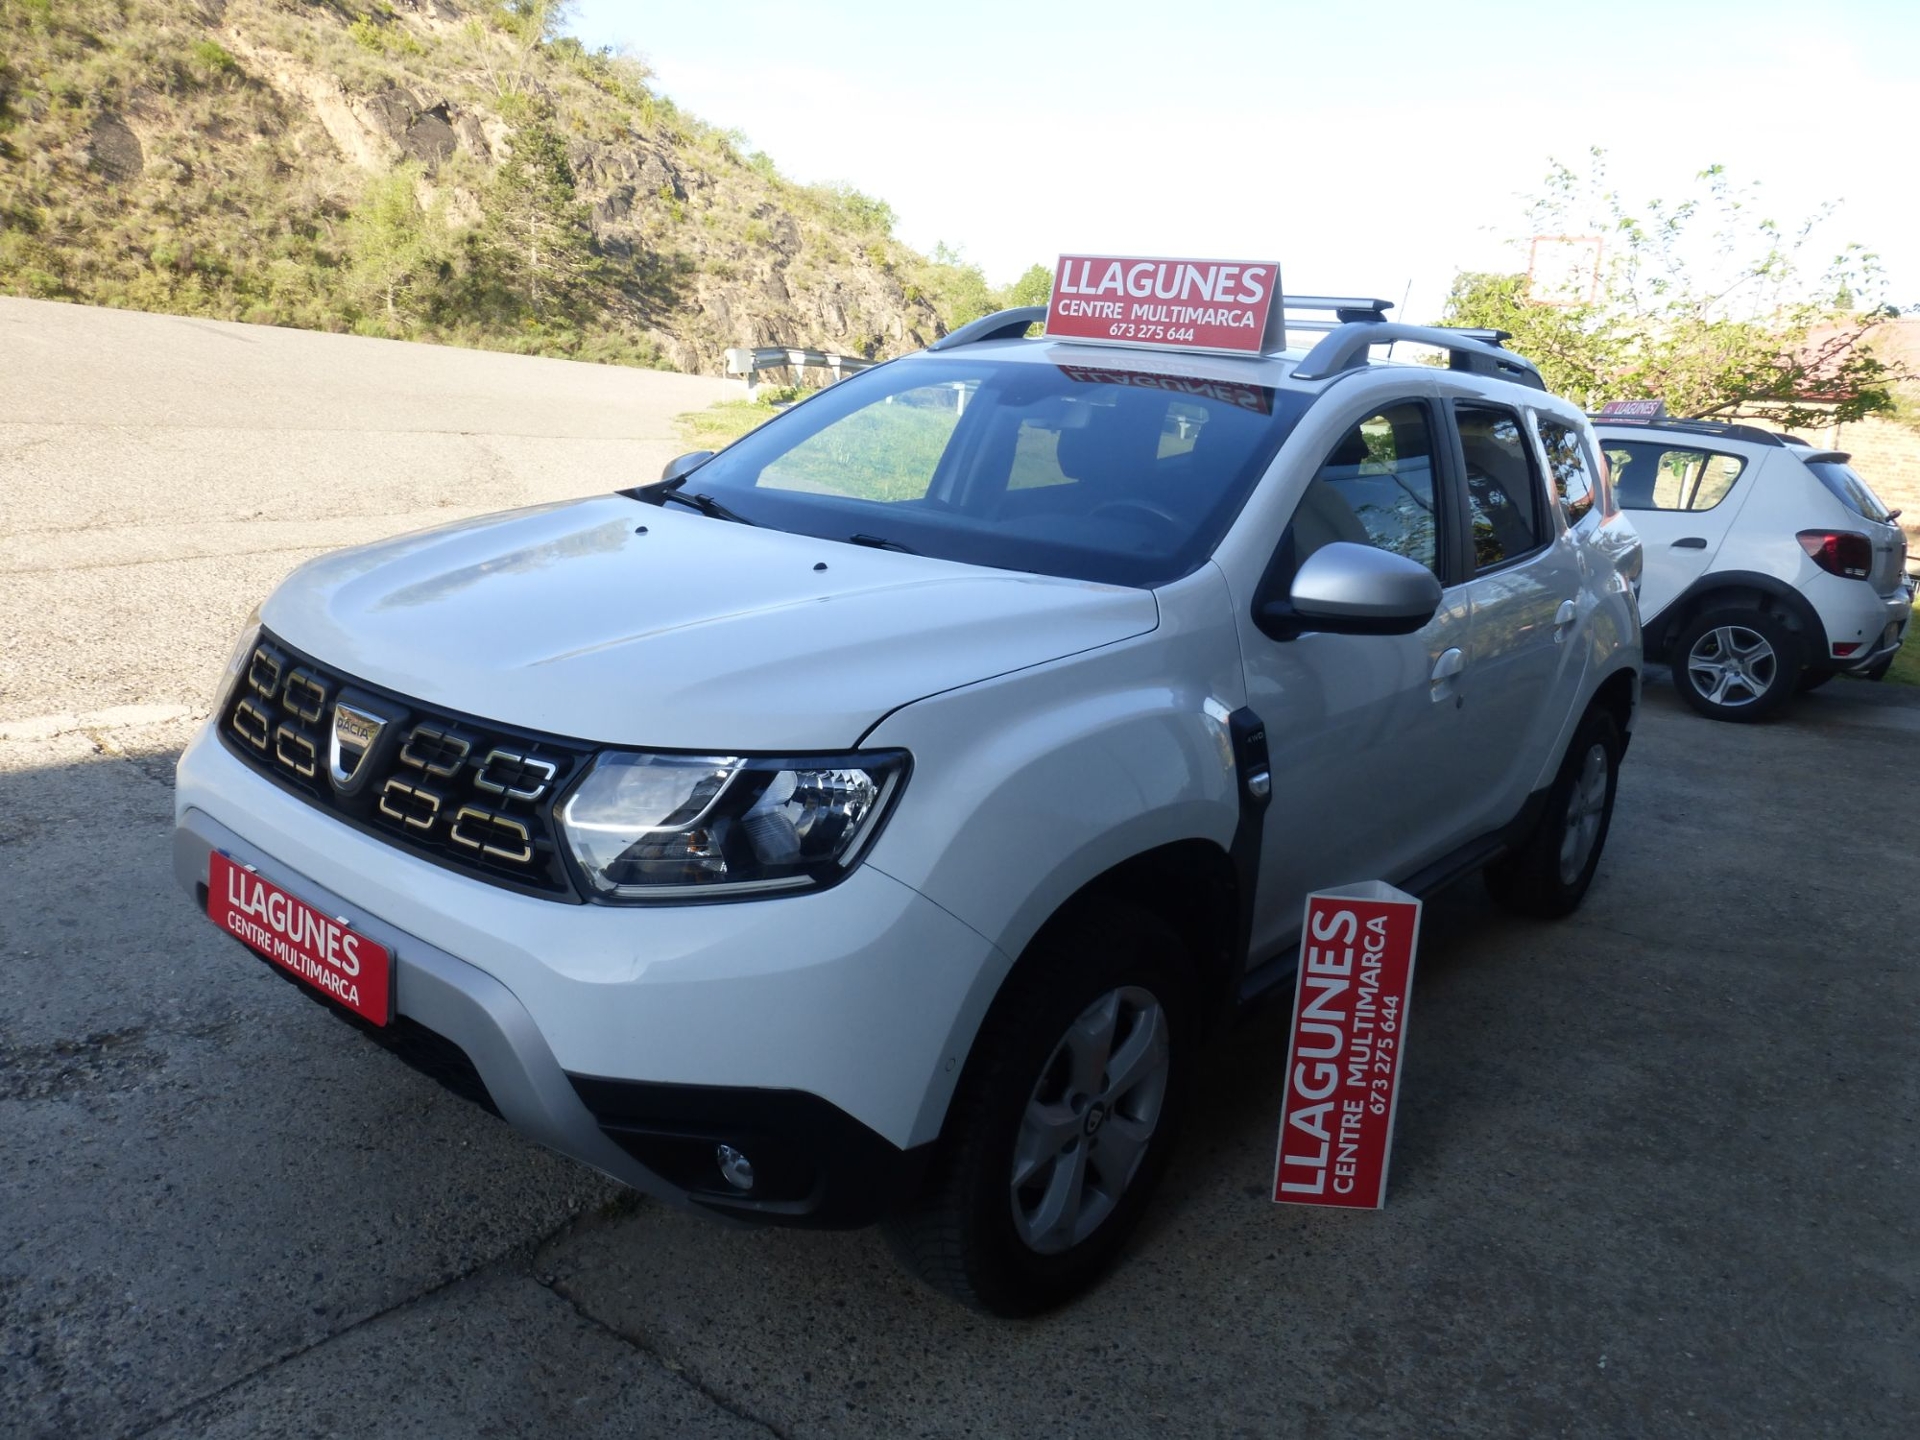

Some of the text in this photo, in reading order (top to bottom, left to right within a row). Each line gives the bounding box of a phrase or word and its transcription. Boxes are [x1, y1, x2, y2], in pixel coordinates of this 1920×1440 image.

[1058, 299, 1255, 328] CENTRE MULTIMARCA
[1060, 260, 1267, 304] LLAGUNES
[1109, 322, 1195, 342] 673 275 644
[1614, 402, 1658, 415] LLAGUNES
[337, 717, 369, 740] DACIA
[228, 866, 360, 976] LLAGUNES
[227, 911, 360, 1006] CENTRE MULTIMARCA
[1281, 909, 1358, 1195] LLAGUNES
[1333, 915, 1388, 1194] CENTRE MULTIMARCA
[1370, 995, 1400, 1116] 673 275 644
